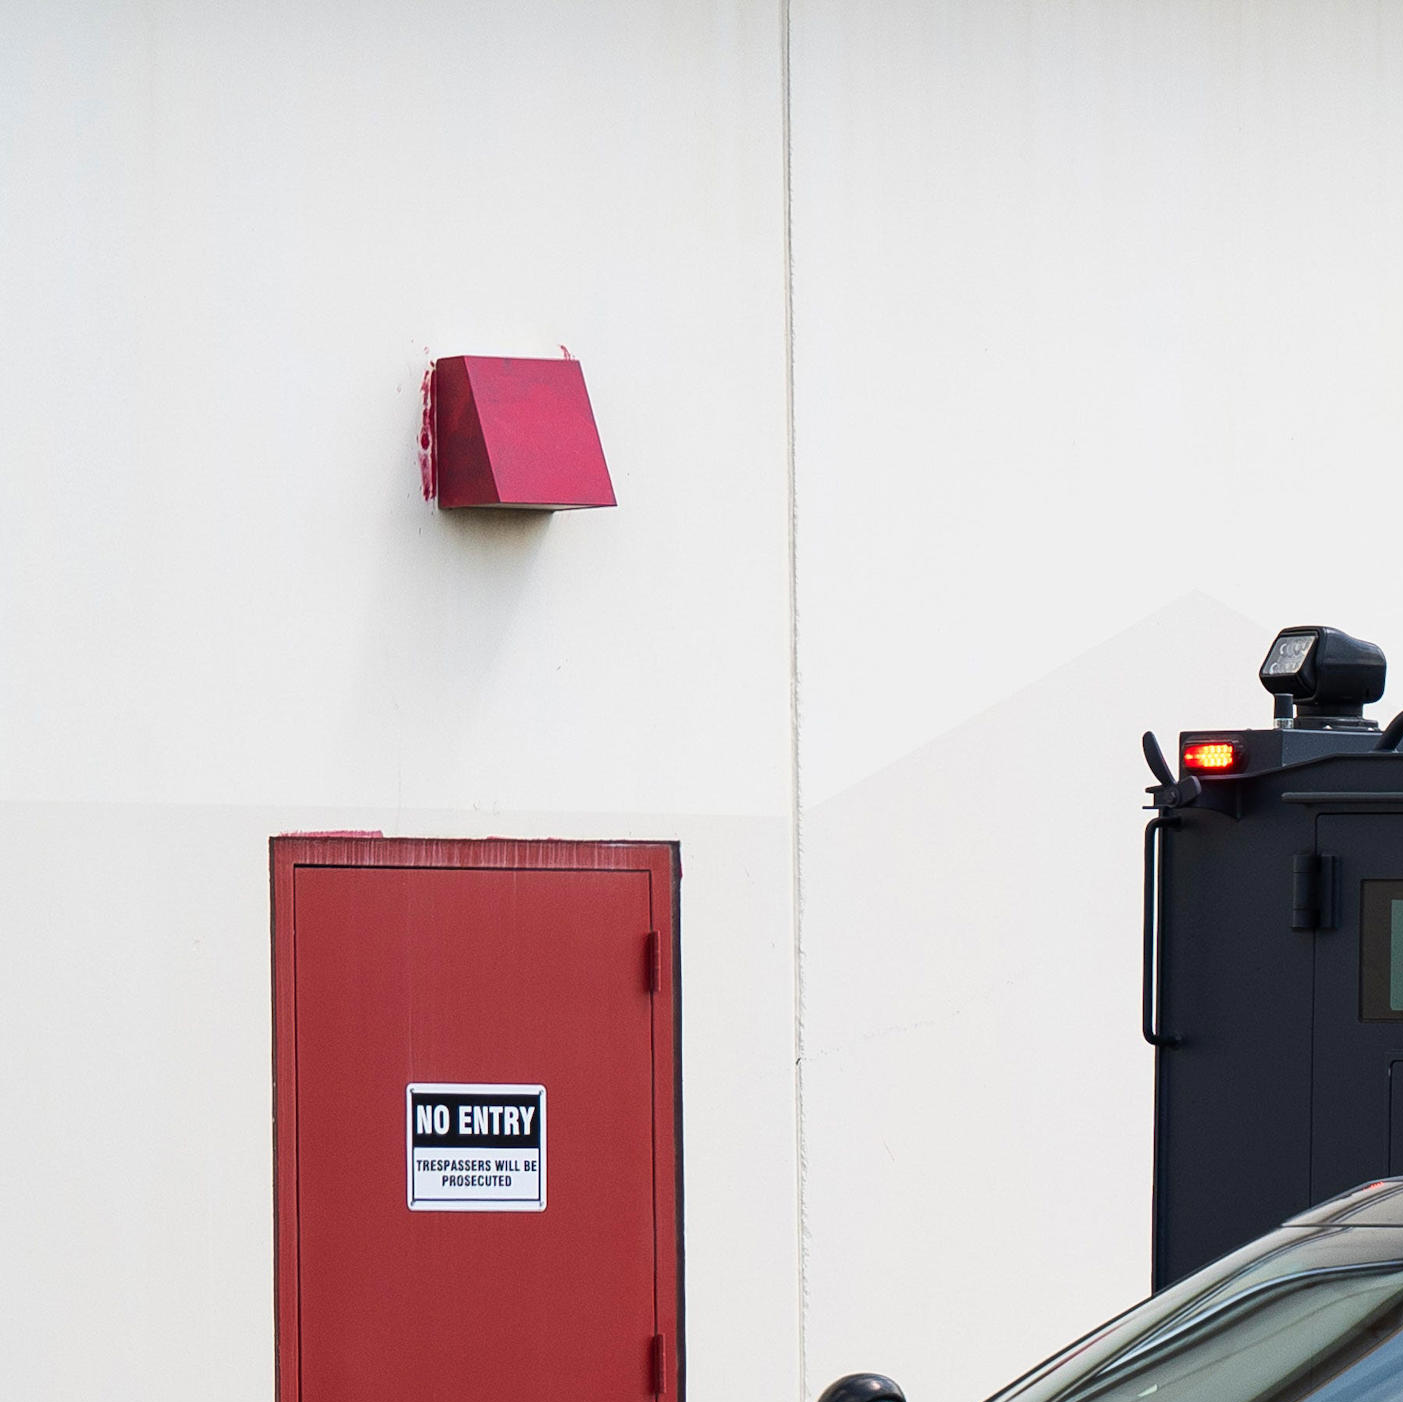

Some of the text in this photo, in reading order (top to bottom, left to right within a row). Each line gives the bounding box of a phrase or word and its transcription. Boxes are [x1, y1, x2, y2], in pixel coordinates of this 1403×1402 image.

[416, 1104, 536, 1136] NO ENTRY
[416, 1159, 537, 1172] TRESPASSERS WILL BE
[442, 1175, 512, 1187] PROSECUTED
